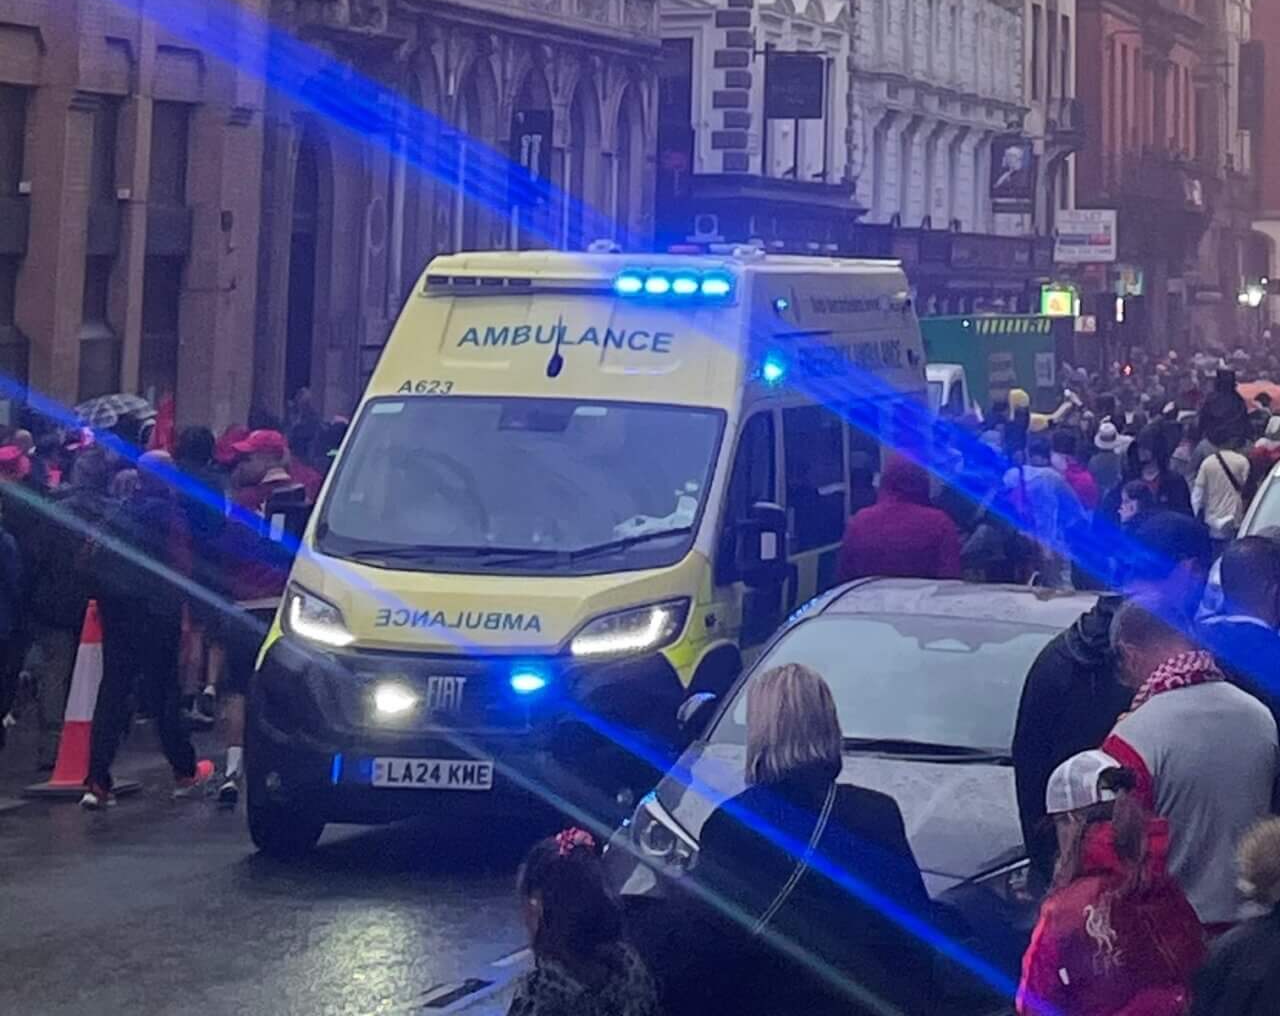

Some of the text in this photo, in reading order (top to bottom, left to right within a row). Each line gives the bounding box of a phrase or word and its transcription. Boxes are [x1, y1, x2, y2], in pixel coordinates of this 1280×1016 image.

[457, 324, 674, 354] AMBULANCE
[397, 379, 454, 394] A623
[427, 675, 467, 709] FIAT
[386, 761, 442, 784] LA24
